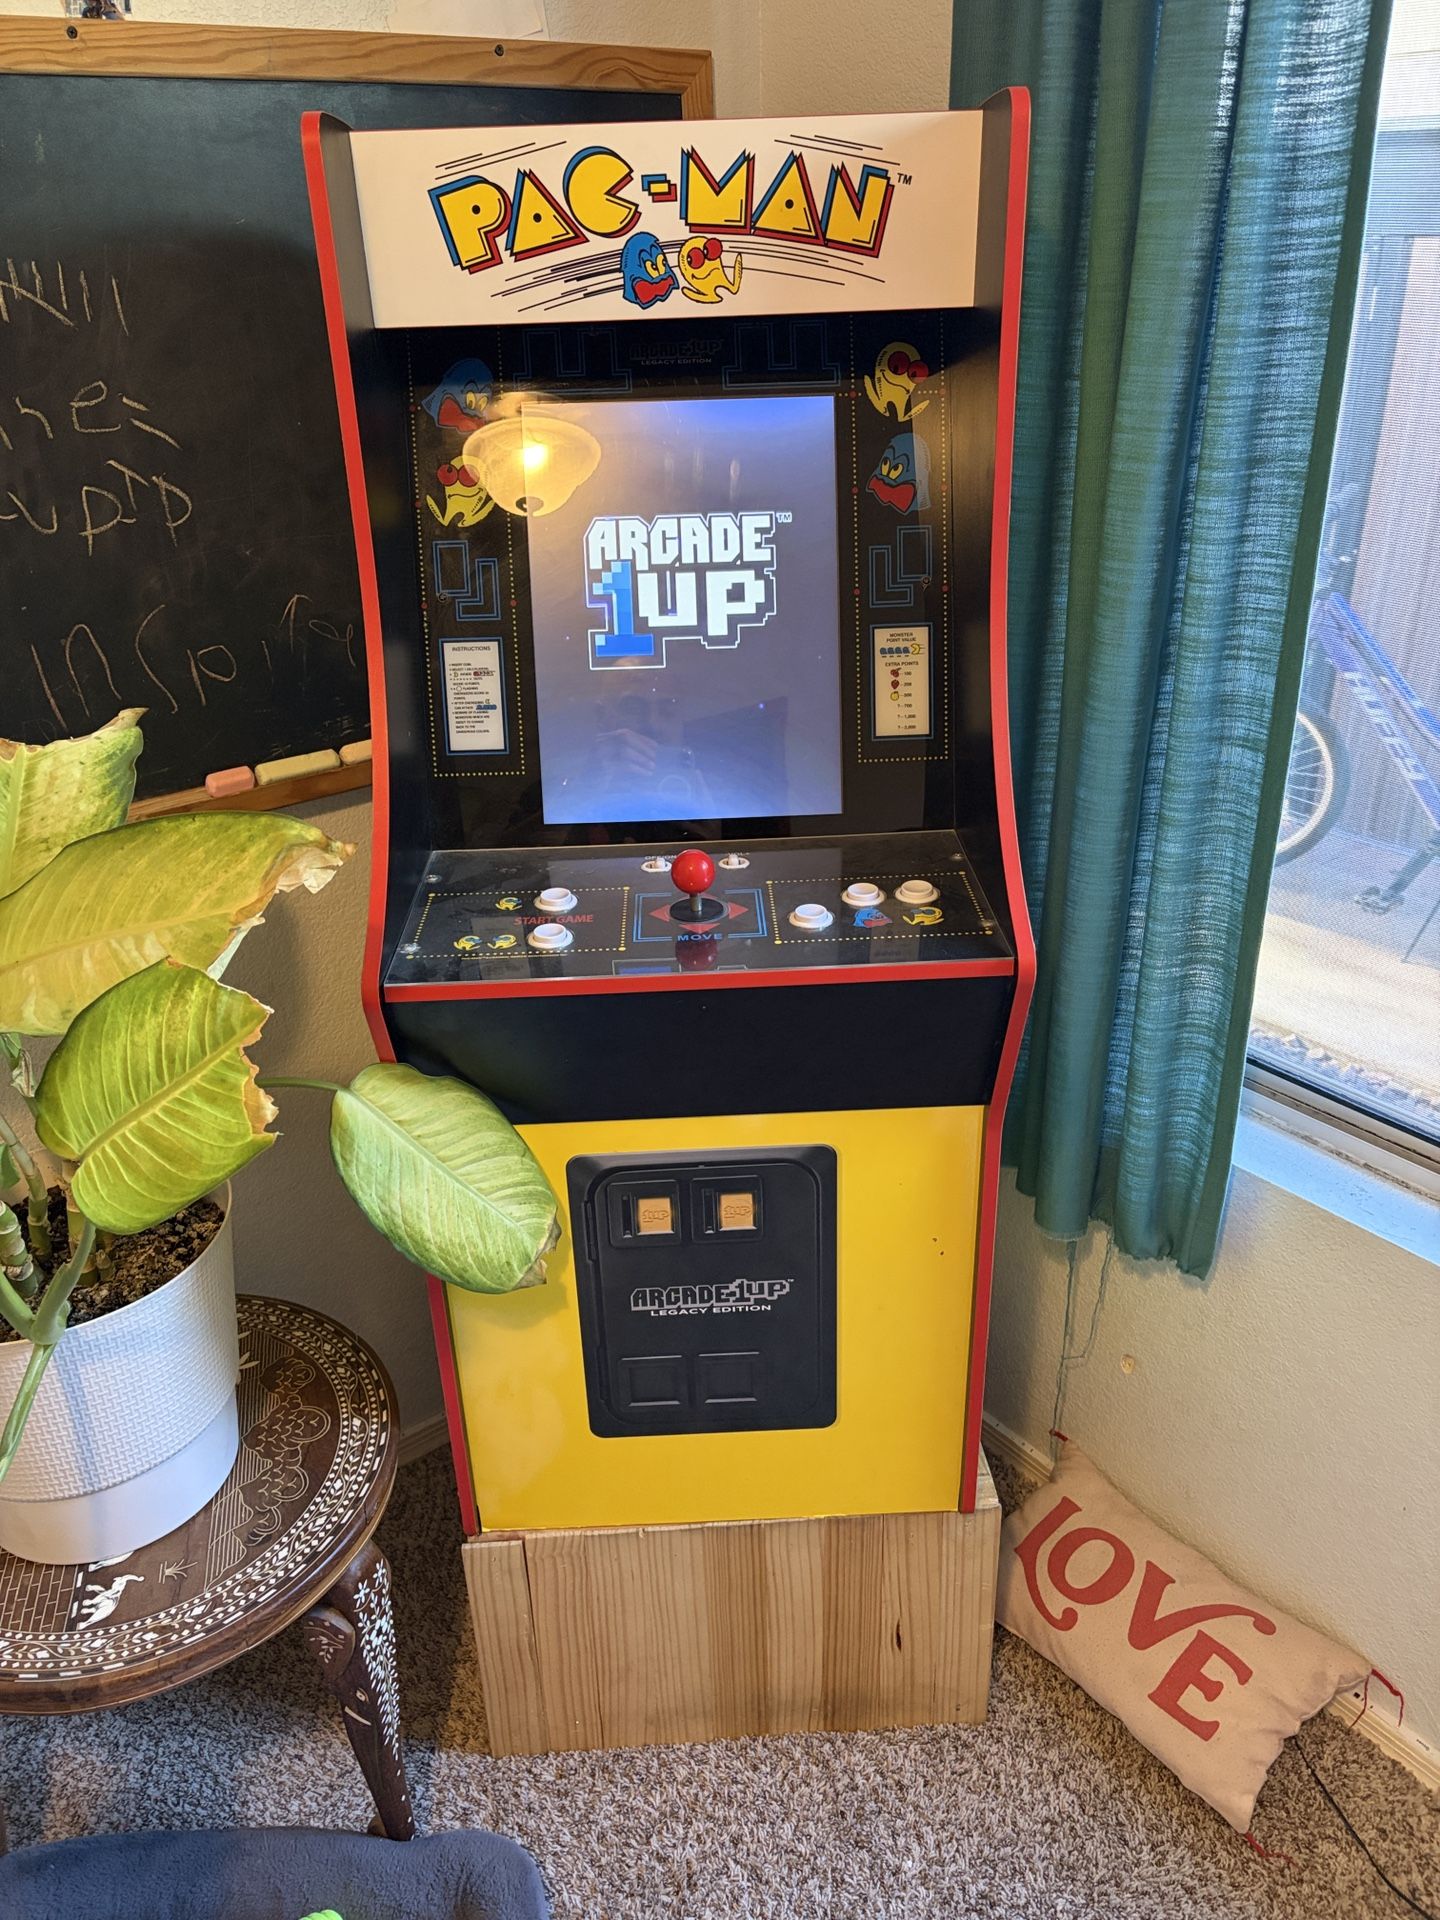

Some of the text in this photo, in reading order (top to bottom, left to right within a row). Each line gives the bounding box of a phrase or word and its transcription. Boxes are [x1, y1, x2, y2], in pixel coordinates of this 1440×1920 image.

[428, 145, 895, 275] PAC-MAN
[586, 513, 773, 571] ARCADE
[592, 560, 766, 657] 1UP
[1343, 669, 1429, 782] HUFFY
[513, 913, 594, 926] START GAME
[677, 933, 724, 942] MOVE
[650, 1304, 772, 1317] LEGACY EDITION
[1014, 1496, 1277, 1742] LOVE
